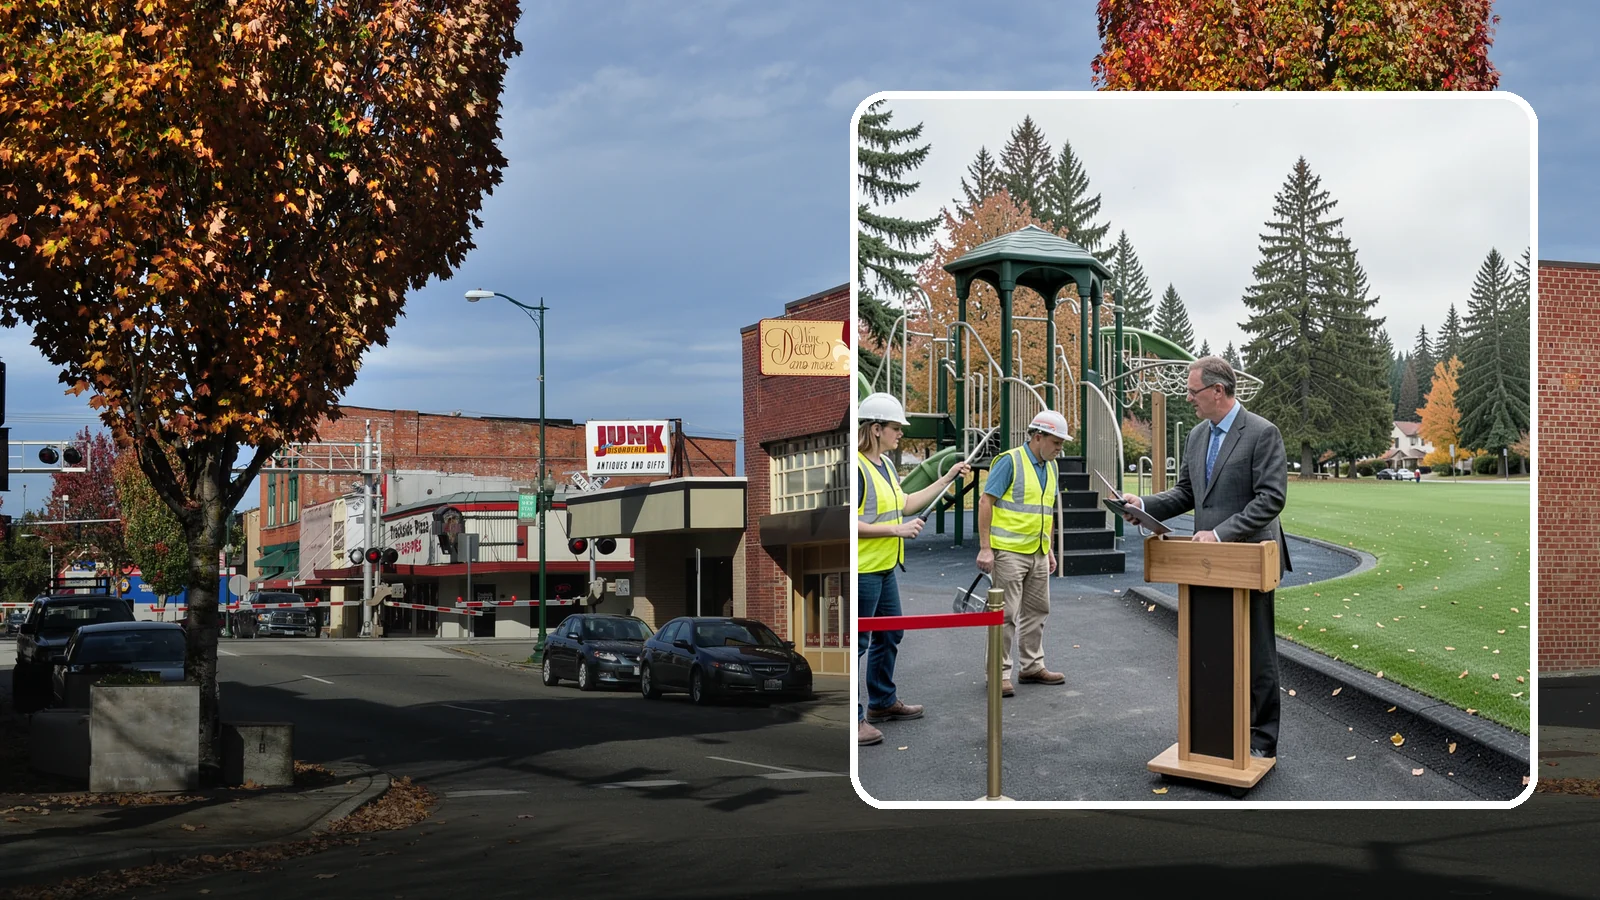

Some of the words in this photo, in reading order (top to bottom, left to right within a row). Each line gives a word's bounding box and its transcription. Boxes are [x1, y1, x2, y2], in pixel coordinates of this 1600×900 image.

[595, 425, 665, 457] JUNK
[607, 446, 646, 454] DISORDERLY
[597, 461, 628, 470] ANTIQUES
[631, 461, 644, 470] AND
[647, 460, 665, 470] GIFTS
[390, 521, 413, 540] Trackside
[414, 519, 429, 535] Pizza
